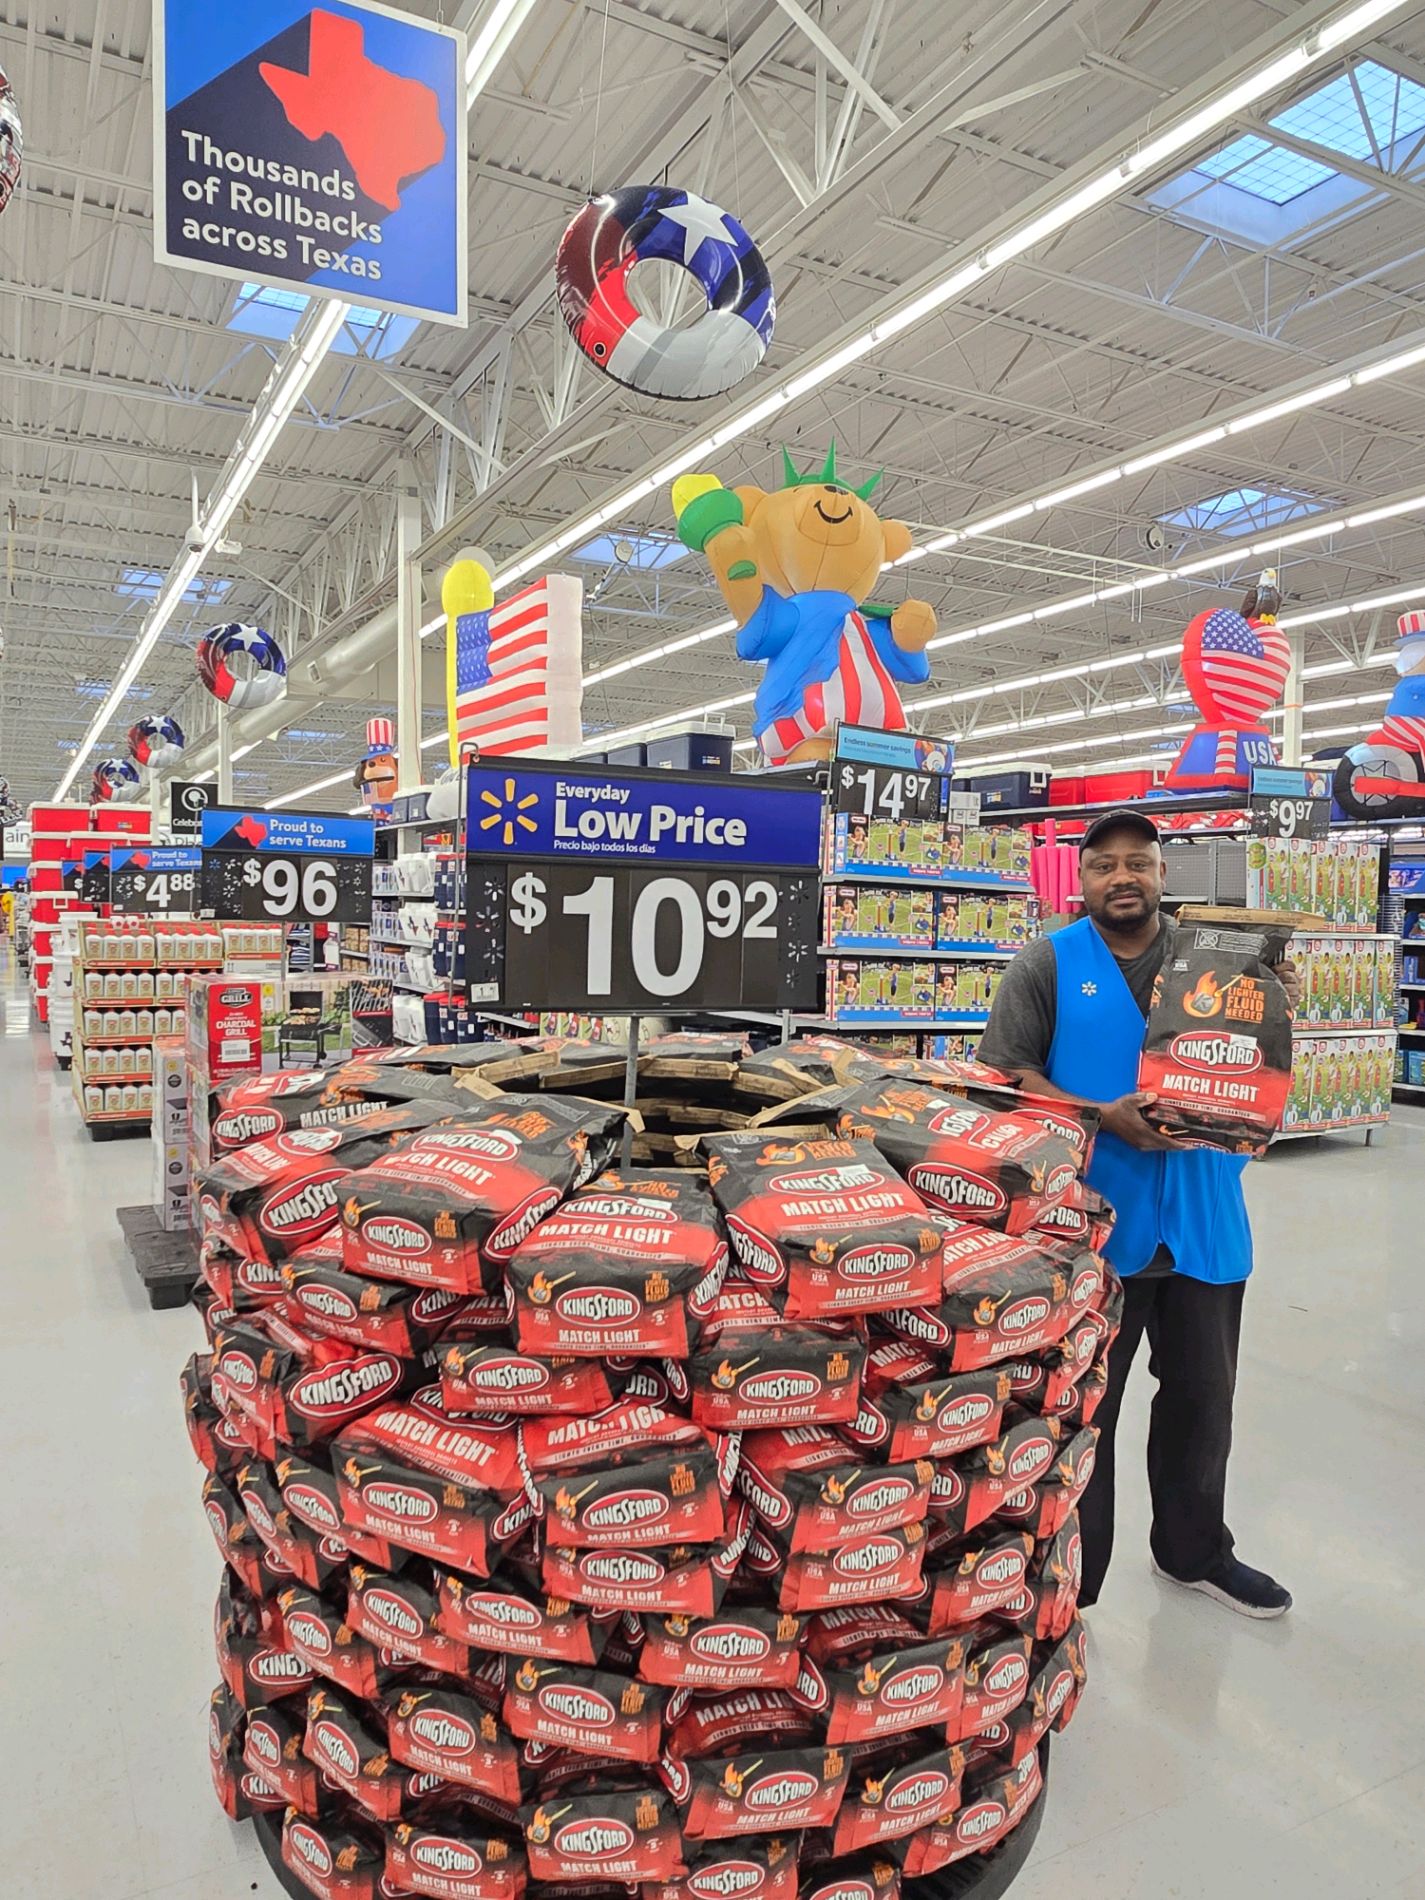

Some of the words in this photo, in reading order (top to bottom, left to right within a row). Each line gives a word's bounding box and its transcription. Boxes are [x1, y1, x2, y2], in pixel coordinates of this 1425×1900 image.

[181, 130, 355, 201] Thousands
[182, 176, 221, 205] of
[230, 183, 382, 243] Rollbacks
[182, 217, 288, 260] across
[296, 235, 381, 280] Texas
[556, 781, 630, 805] Everyday
[270, 818, 304, 832] Proud
[309, 820, 324, 833] to
[554, 799, 642, 840] Low
[649, 805, 748, 847] Price
[269, 835, 303, 847] serve
[306, 835, 347, 849] Texans
[553, 840, 579, 851] Precio
[581, 841, 600, 854] bajo
[601, 843, 625, 853] todos
[626, 843, 638, 853] los
[1228, 988, 1264, 1000] LIGHTER
[1239, 979, 1255, 990] NO
[1225, 1008, 1263, 1021] NEEDED
[1226, 996, 1264, 1011] FLUID
[216, 1020, 256, 1029] CHARCOAL
[225, 1028, 247, 1036] GRILL
[1177, 1039, 1255, 1066] KINGSFORD
[1163, 1074, 1211, 1095] MATCH
[1214, 1080, 1258, 1102] LIGHT
[217, 1114, 276, 1141] KINGSFORD
[300, 1106, 345, 1128] MATCH
[435, 1155, 492, 1185] LIGHT
[778, 1171, 875, 1192] KINGSFORD
[915, 1171, 997, 1207] KINGSFORD
[563, 1199, 667, 1220] KINGSFORD
[780, 1197, 848, 1217] MATCH
[850, 1193, 904, 1212] LIGHT
[368, 1224, 424, 1248] KINGSFORD
[539, 1223, 608, 1237] MATCH
[614, 1225, 673, 1245] LIGHT
[367, 1252, 401, 1269] MATCH
[402, 1259, 433, 1275] LIGHT
[844, 1250, 909, 1276] KINGSFORD
[812, 1273, 827, 1282] USA
[835, 1283, 874, 1300] MATCH
[877, 1280, 910, 1296] LIGHT
[535, 1312, 549, 1321] USA
[563, 1293, 633, 1321] KINGSFORD
[1003, 1304, 1046, 1329] KINGSFORD
[559, 1329, 600, 1343] MATCH
[603, 1329, 640, 1343] LIGHT
[991, 1338, 1020, 1354] MATCH
[1021, 1330, 1044, 1347] LIGHT
[300, 1360, 392, 1405] KINGSFORD
[475, 1364, 542, 1389] KINGSFORD
[746, 1377, 814, 1400] KINGSFORD
[475, 1395, 516, 1405] MATCH
[518, 1395, 553, 1405] LIGHT
[713, 1397, 729, 1406] USA
[737, 1407, 778, 1419] MATCH
[781, 1405, 816, 1416] LIGHT
[942, 1401, 989, 1426] KINGSFORD
[374, 1411, 434, 1446] MATCH
[436, 1431, 496, 1467] LIGHT
[914, 1428, 928, 1437] USA
[930, 1435, 959, 1451] MATCH
[960, 1428, 985, 1444] LIGHT
[368, 1492, 430, 1520] KINGSFORD
[590, 1498, 661, 1526] KINGSFORD
[852, 1486, 909, 1513] KINGSFORD
[366, 1514, 402, 1533] MATCH
[404, 1525, 435, 1543] LIGHT
[820, 1511, 835, 1521] USA
[839, 1521, 874, 1536] MATCH
[875, 1509, 905, 1527] LIGHT
[587, 1530, 632, 1542] MATCH
[635, 1524, 671, 1538] LIGHT
[587, 1557, 657, 1582] KINGSFORD
[840, 1544, 899, 1572] KINGSFORD
[981, 1557, 1022, 1582] KINGSFORD
[582, 1585, 629, 1600] MATCH
[630, 1590, 663, 1600] LIGHT
[829, 1580, 868, 1594] MATCH
[870, 1573, 900, 1591] LIGHT
[368, 1595, 417, 1634] KINGSFORD
[468, 1623, 507, 1639] MATCH
[509, 1633, 542, 1647] LIGHT
[697, 1632, 764, 1658] KINGSFORD
[685, 1663, 726, 1677] MATCH
[728, 1667, 763, 1678] LIGHT
[886, 1674, 938, 1700] KINGSFORD
[545, 1693, 608, 1721] KINGSFORD
[696, 1692, 761, 1727] MATCH
[875, 1710, 910, 1726] MATCH
[911, 1701, 940, 1718] LIGHT
[415, 1717, 470, 1748] KINGSFORD
[538, 1719, 576, 1736] MATCH
[579, 1730, 613, 1745] LIGHT
[317, 1729, 354, 1774] KINGSFORD
[410, 1745, 442, 1767] MATCH
[444, 1758, 473, 1776] LIGHT
[752, 1780, 812, 1805] KINGSFORD
[890, 1779, 943, 1807] KINGSFORD
[736, 1812, 774, 1824] MATCH
[777, 1807, 812, 1821] LIGHT
[880, 1815, 914, 1832] MATCH
[916, 1803, 941, 1823] LIGHT
[561, 1826, 627, 1854] KINGSFORD
[417, 1846, 475, 1871] KINGSFORD
[561, 1862, 601, 1873] MATCH
[603, 1860, 637, 1872] LIGHT
[412, 1872, 448, 1888] MATCH
[450, 1881, 482, 1896] LIGHT
[694, 1870, 758, 1894] KINGSFORD
